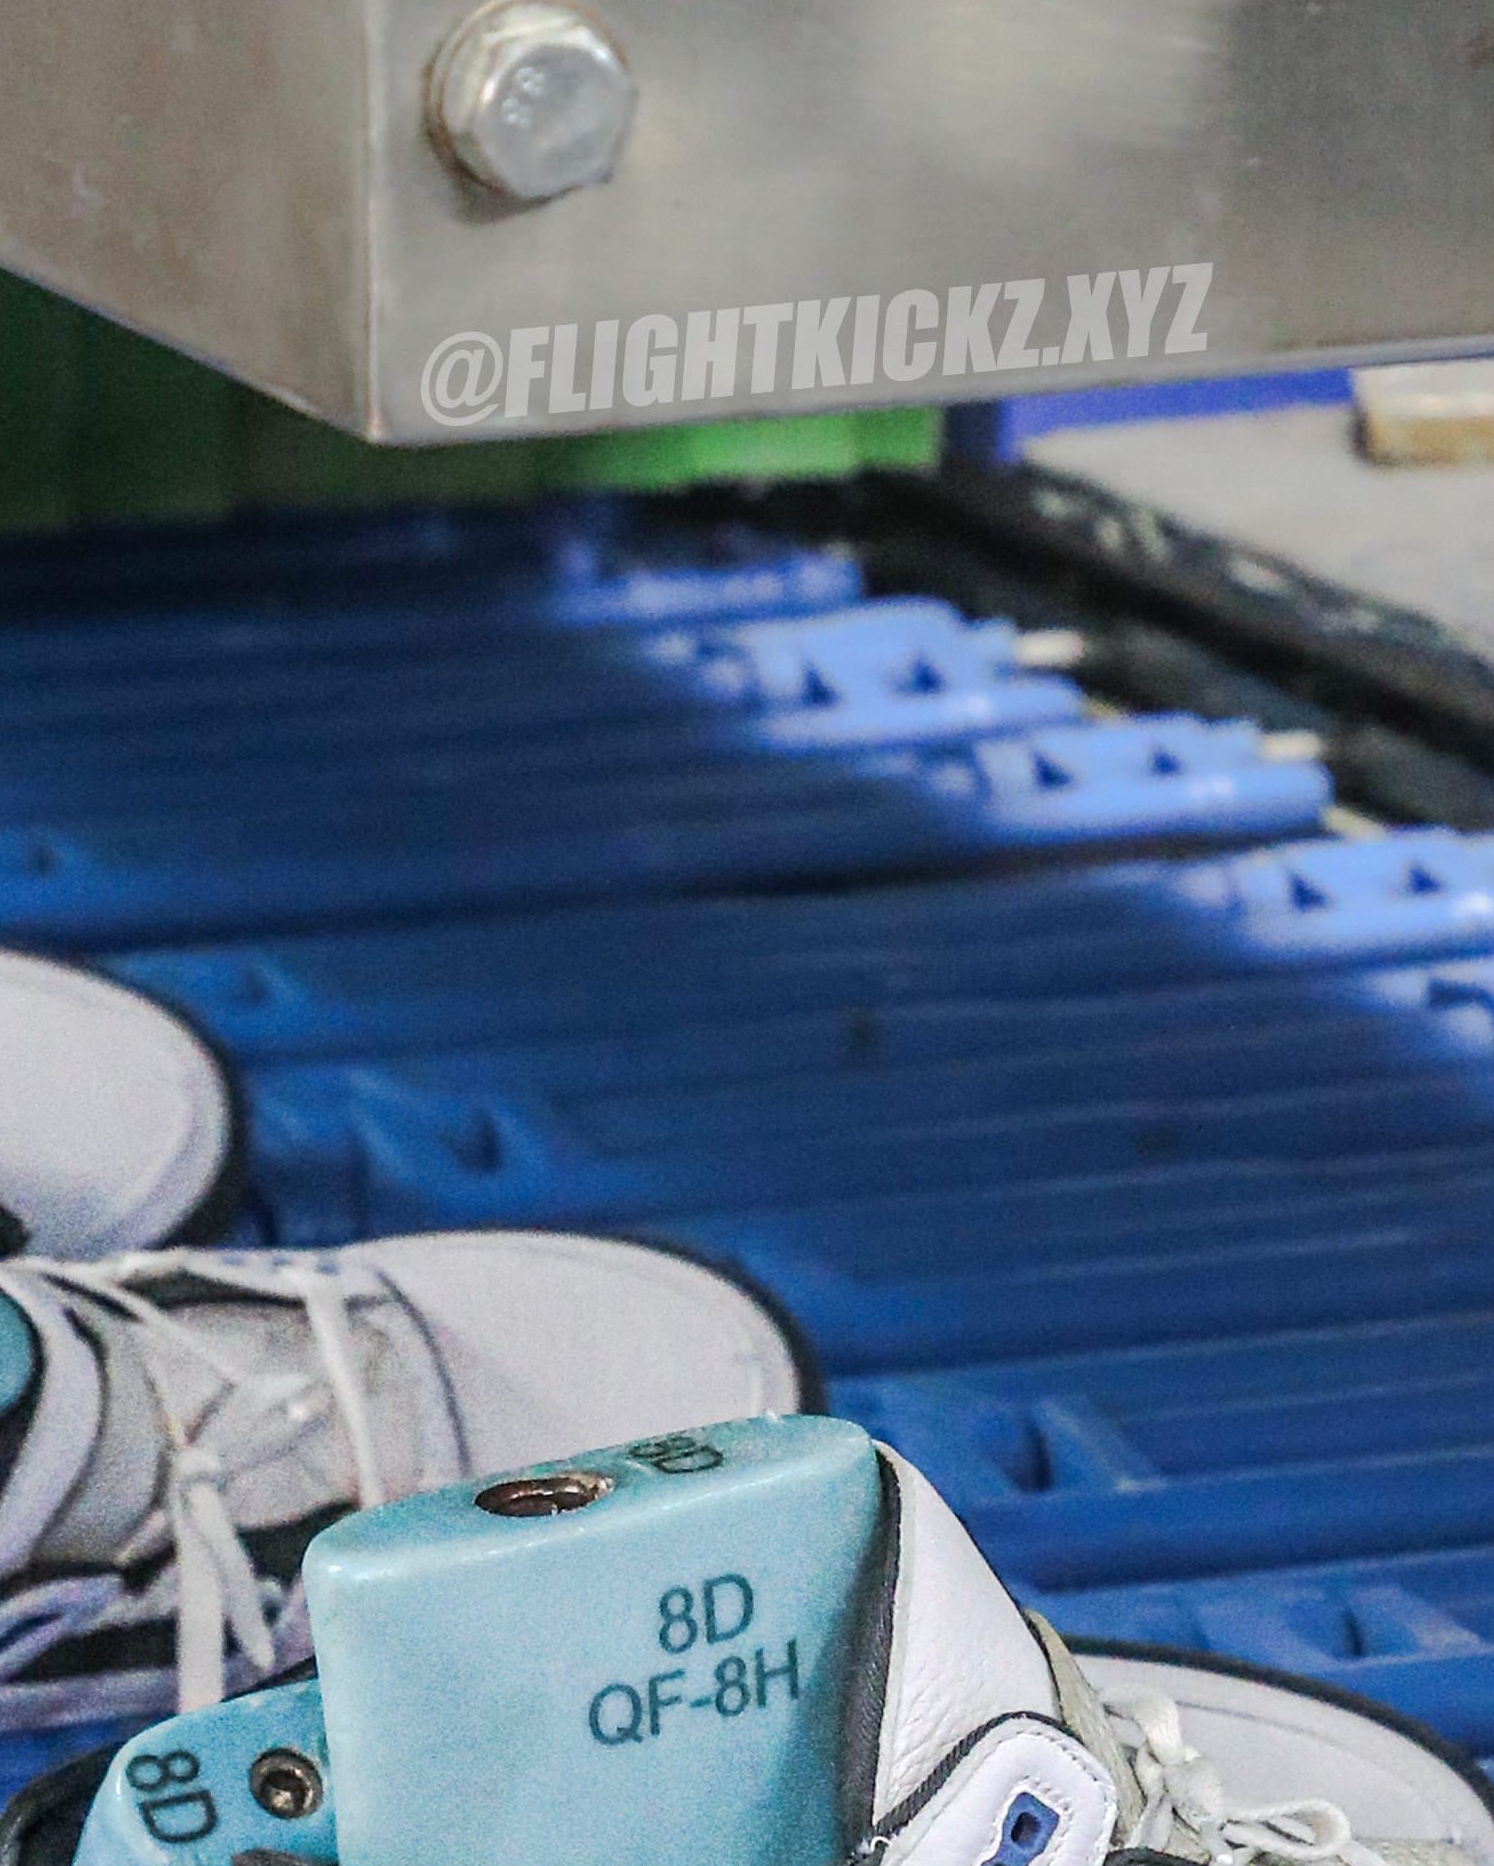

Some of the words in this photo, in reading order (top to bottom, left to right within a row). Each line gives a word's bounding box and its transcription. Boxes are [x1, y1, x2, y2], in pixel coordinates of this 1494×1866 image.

[657, 1573, 755, 1656] 8D
[588, 1639, 801, 1747] QF-8H
[125, 1746, 219, 1845] 8D
